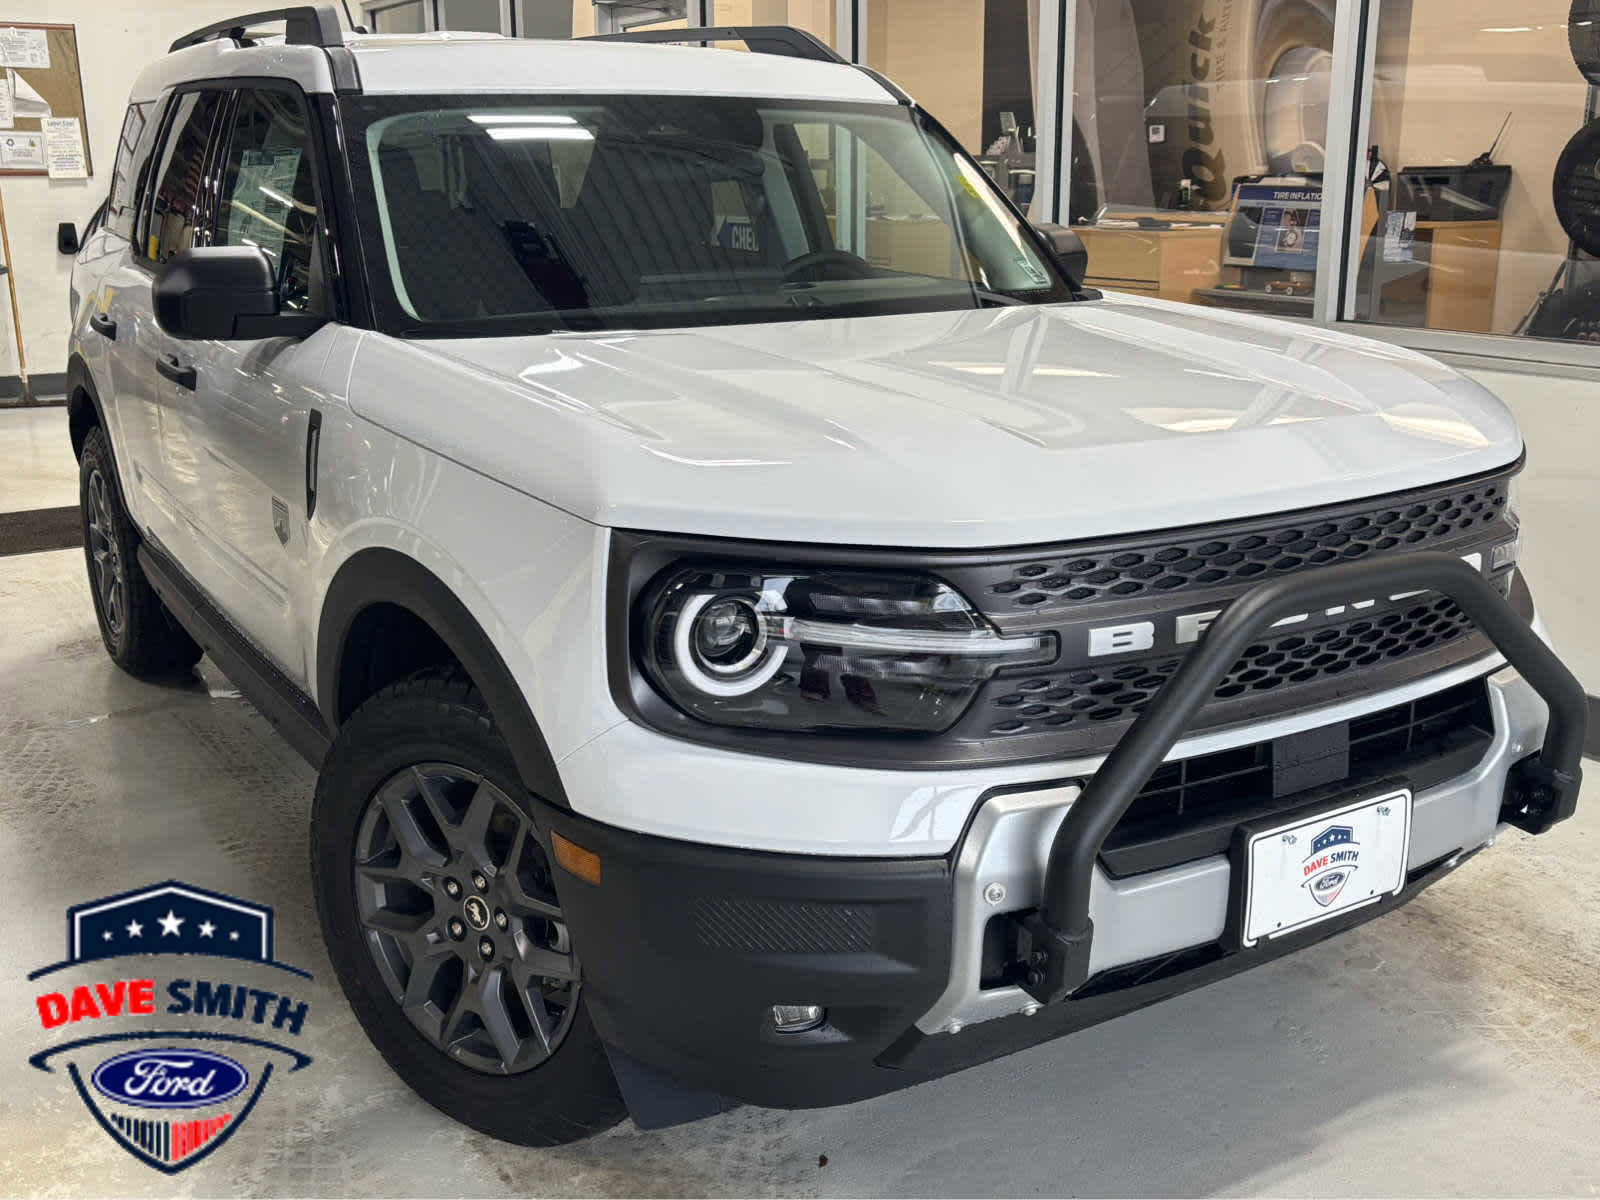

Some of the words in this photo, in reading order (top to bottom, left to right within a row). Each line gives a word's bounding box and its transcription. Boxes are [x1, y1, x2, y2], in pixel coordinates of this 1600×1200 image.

[1273, 191, 1289, 200] TIRE
[1290, 192, 1322, 200] INFLATIO
[1303, 856, 1328, 876] DAVE
[1330, 850, 1359, 863] SMITH
[1320, 875, 1341, 889] Ford
